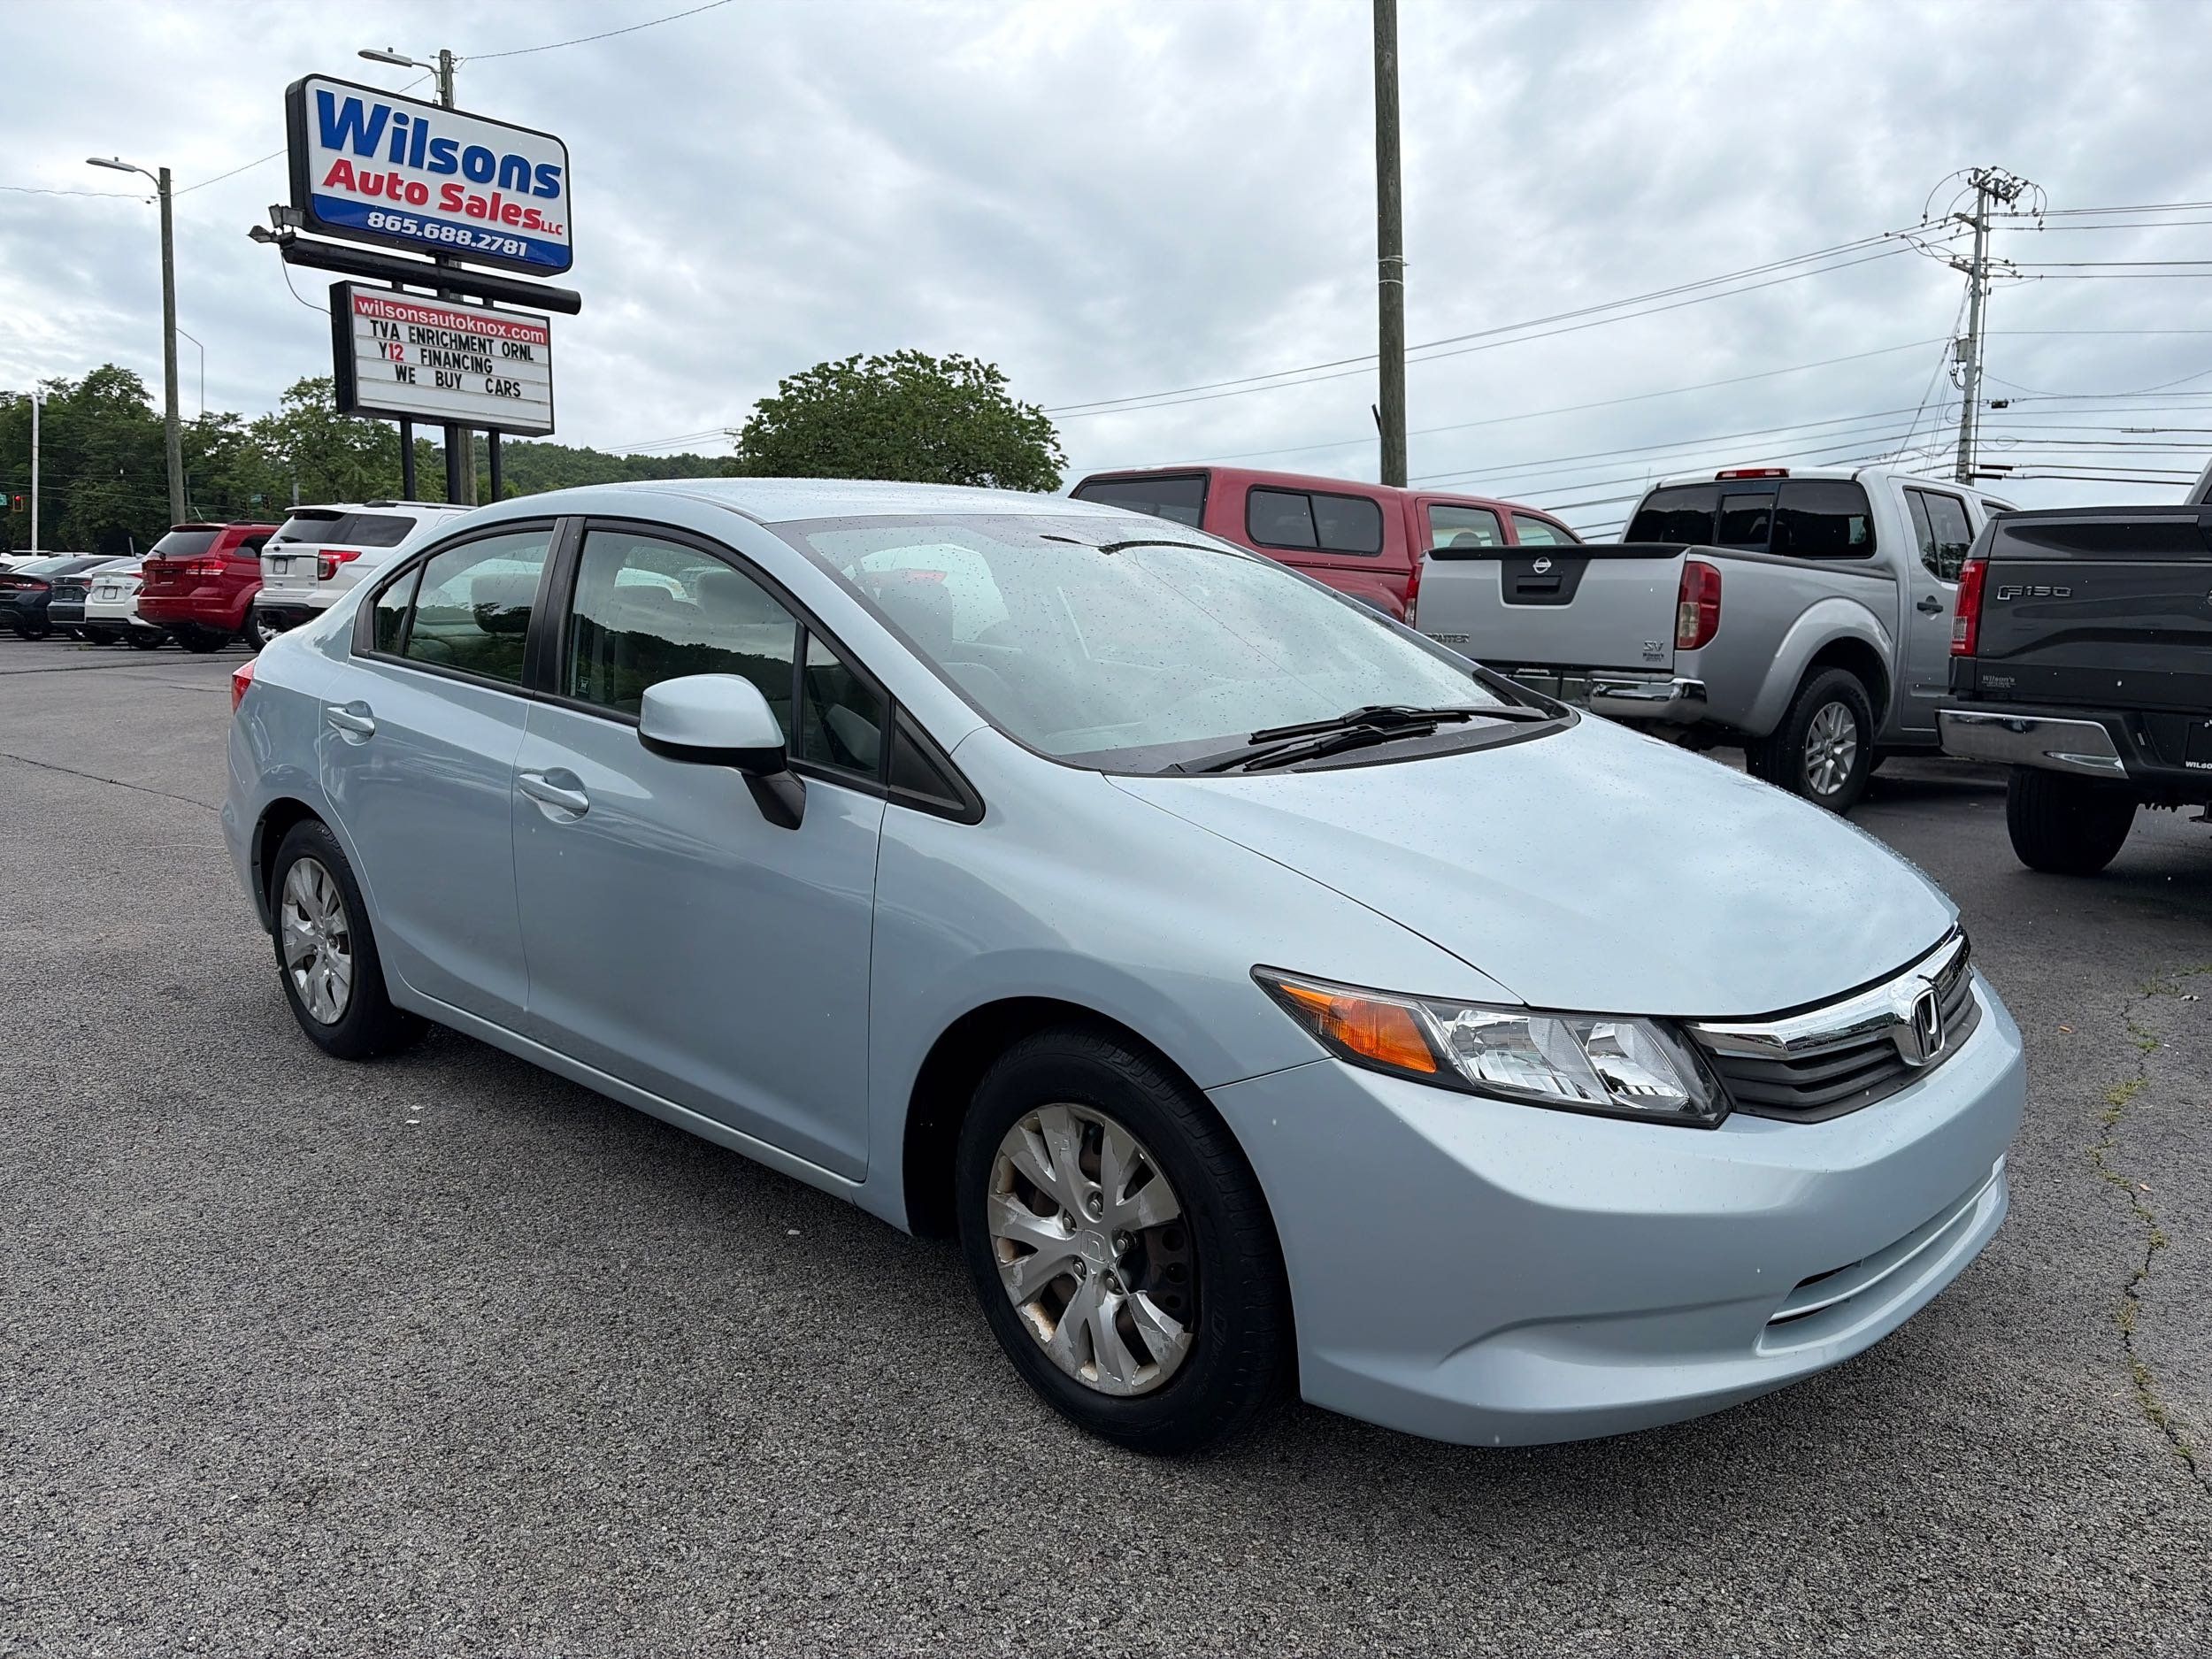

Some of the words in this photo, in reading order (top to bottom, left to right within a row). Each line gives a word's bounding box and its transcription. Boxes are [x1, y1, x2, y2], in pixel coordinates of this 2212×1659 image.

[316, 88, 562, 198] Wilsons
[322, 158, 429, 205] Auto
[438, 182, 541, 230] Sales
[540, 219, 563, 235] LLC
[367, 211, 527, 257] 865.688.2781
[358, 300, 544, 344] wilsonsautoknox.com
[370, 319, 400, 341] TVA
[408, 326, 494, 355] ENRICHMENT
[502, 342, 534, 361] ORNL
[378, 342, 404, 361] Y12
[420, 349, 493, 374] FINANCING
[396, 365, 416, 384] WE
[435, 371, 462, 389] BUY
[486, 378, 521, 397] CARS
[1997, 585, 2071, 600] F150
[1643, 640, 1663, 651] SV
